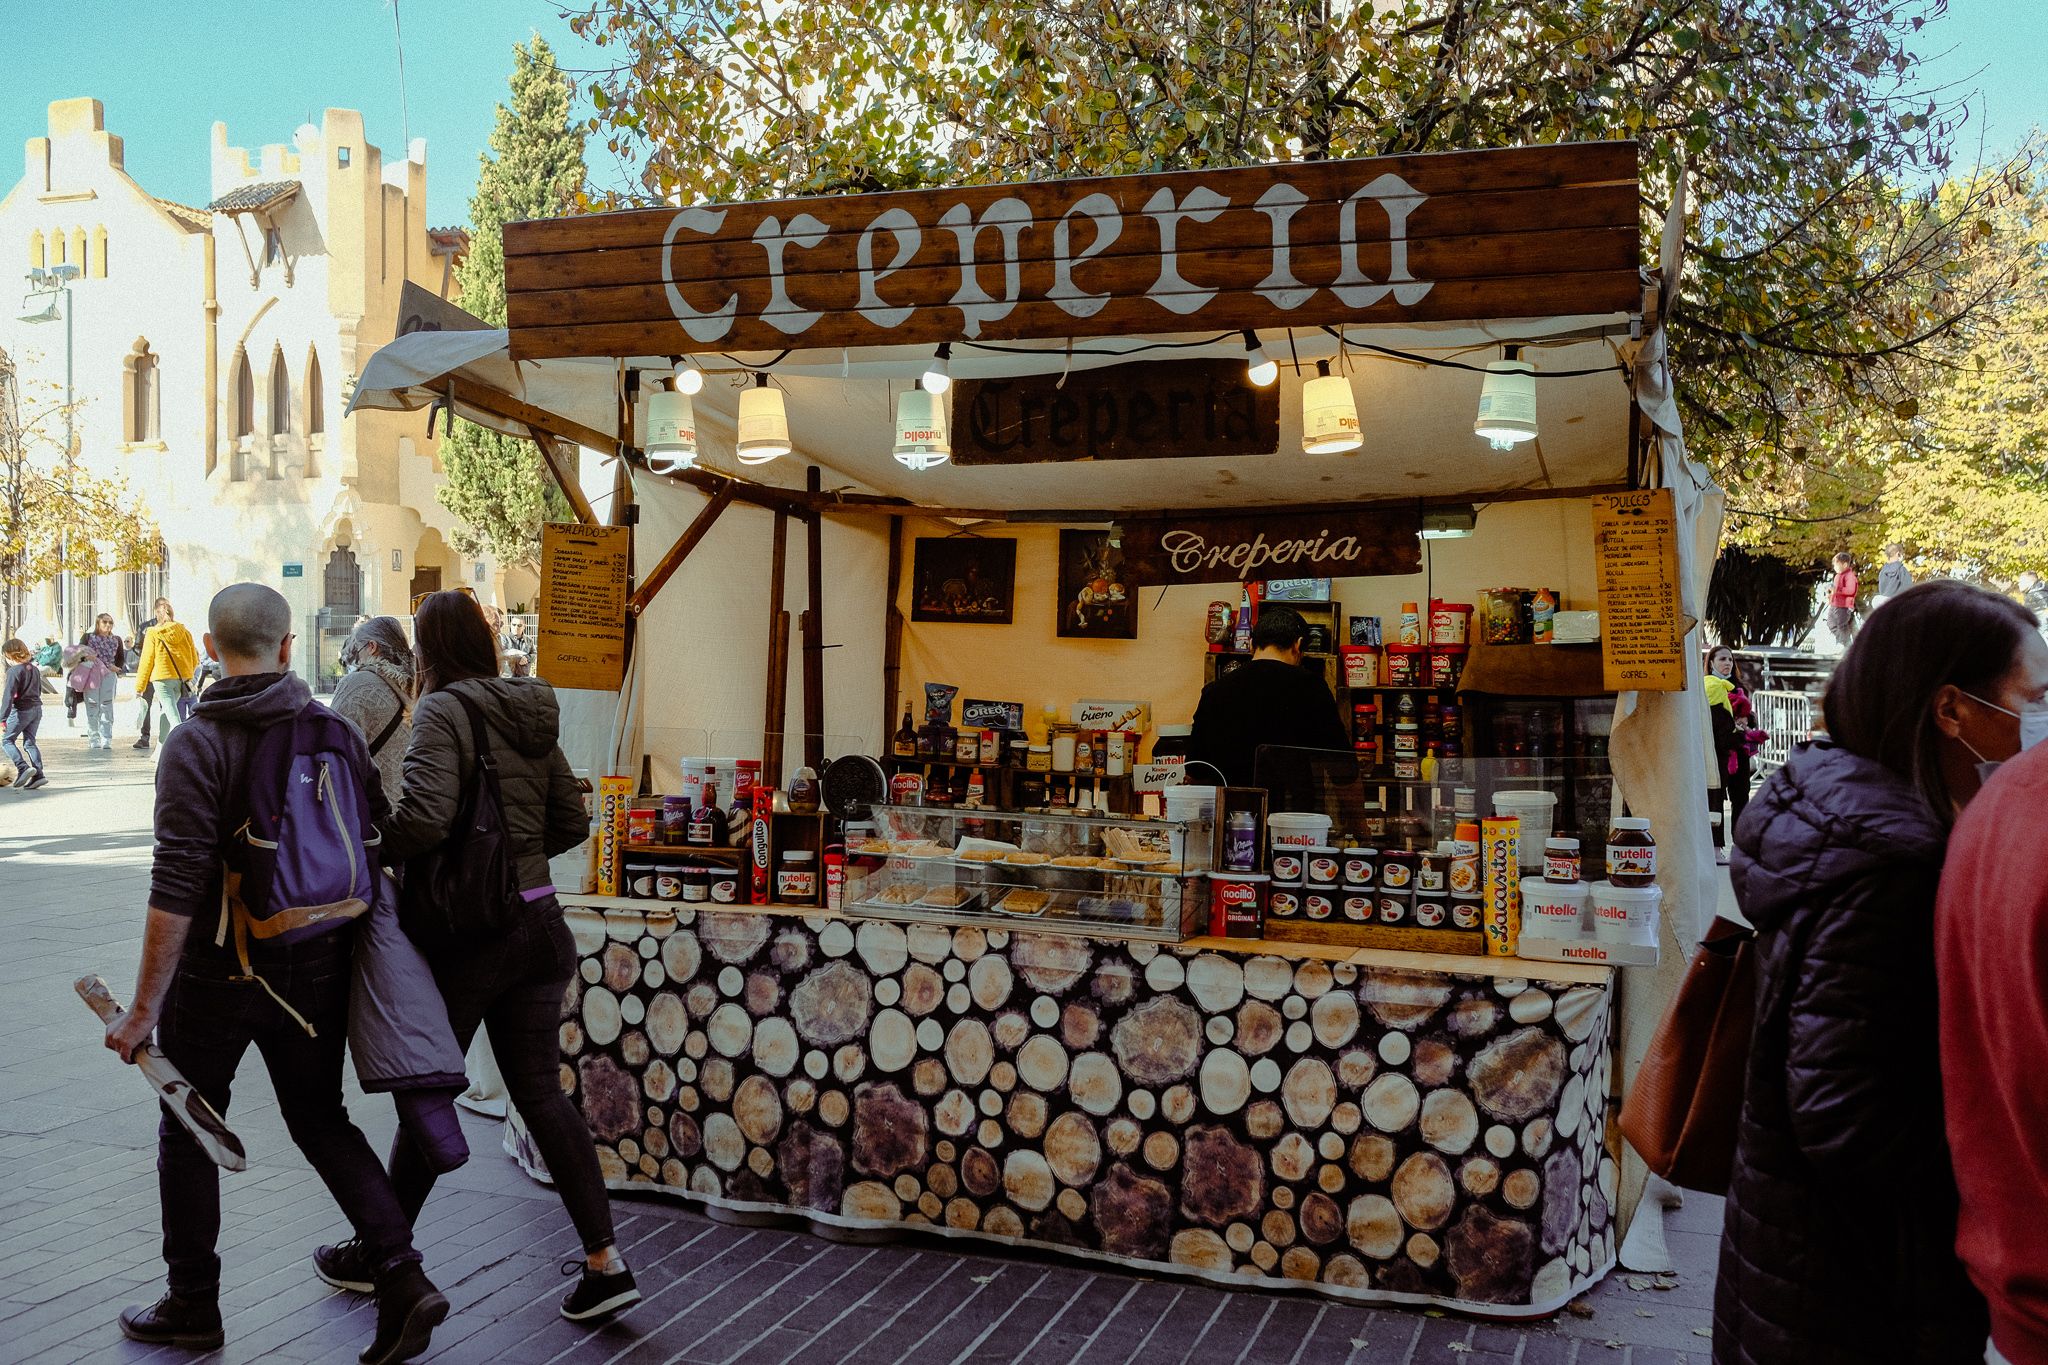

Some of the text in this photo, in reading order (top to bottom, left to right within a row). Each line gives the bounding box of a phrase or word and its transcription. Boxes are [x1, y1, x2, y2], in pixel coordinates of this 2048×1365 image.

[662, 173, 1435, 342] Creperia
[971, 378, 1260, 457] Creperia
[904, 430, 941, 442] nutella
[1162, 529, 1361, 579] Creperia
[1620, 670, 1648, 679] GOFRES
[965, 706, 1003, 719] OREO
[1081, 711, 1113, 721] bueno
[892, 779, 918, 789] nocilla
[600, 794, 615, 883] Lacasitos
[754, 820, 768, 866] conguitos
[1277, 835, 1316, 846] nutella
[1613, 848, 1653, 859] nutella
[1546, 861, 1571, 869] nutella
[779, 873, 812, 882] nutella
[1223, 888, 1253, 899] nocilla
[1489, 840, 1508, 943] Lacasitos
[1534, 904, 1577, 915] nutella
[1562, 947, 1607, 959] nutella
